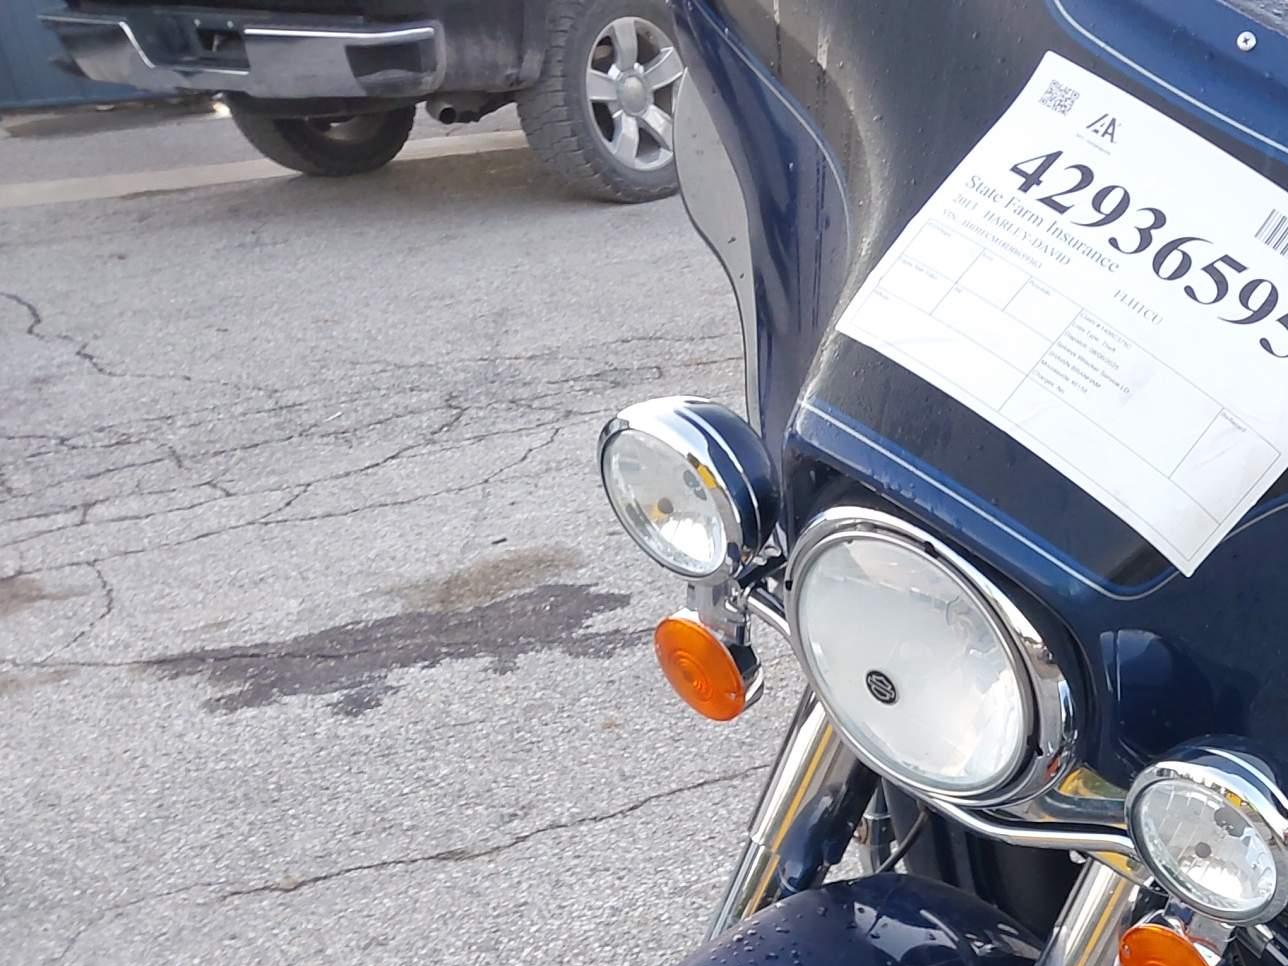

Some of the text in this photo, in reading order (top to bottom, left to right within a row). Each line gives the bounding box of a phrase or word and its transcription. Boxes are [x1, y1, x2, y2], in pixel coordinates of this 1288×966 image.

[965, 175, 1006, 204] State
[1004, 196, 1044, 227] Farm
[1045, 219, 1120, 273] Insurance
[982, 209, 1072, 265] HARLEY-DAVID
